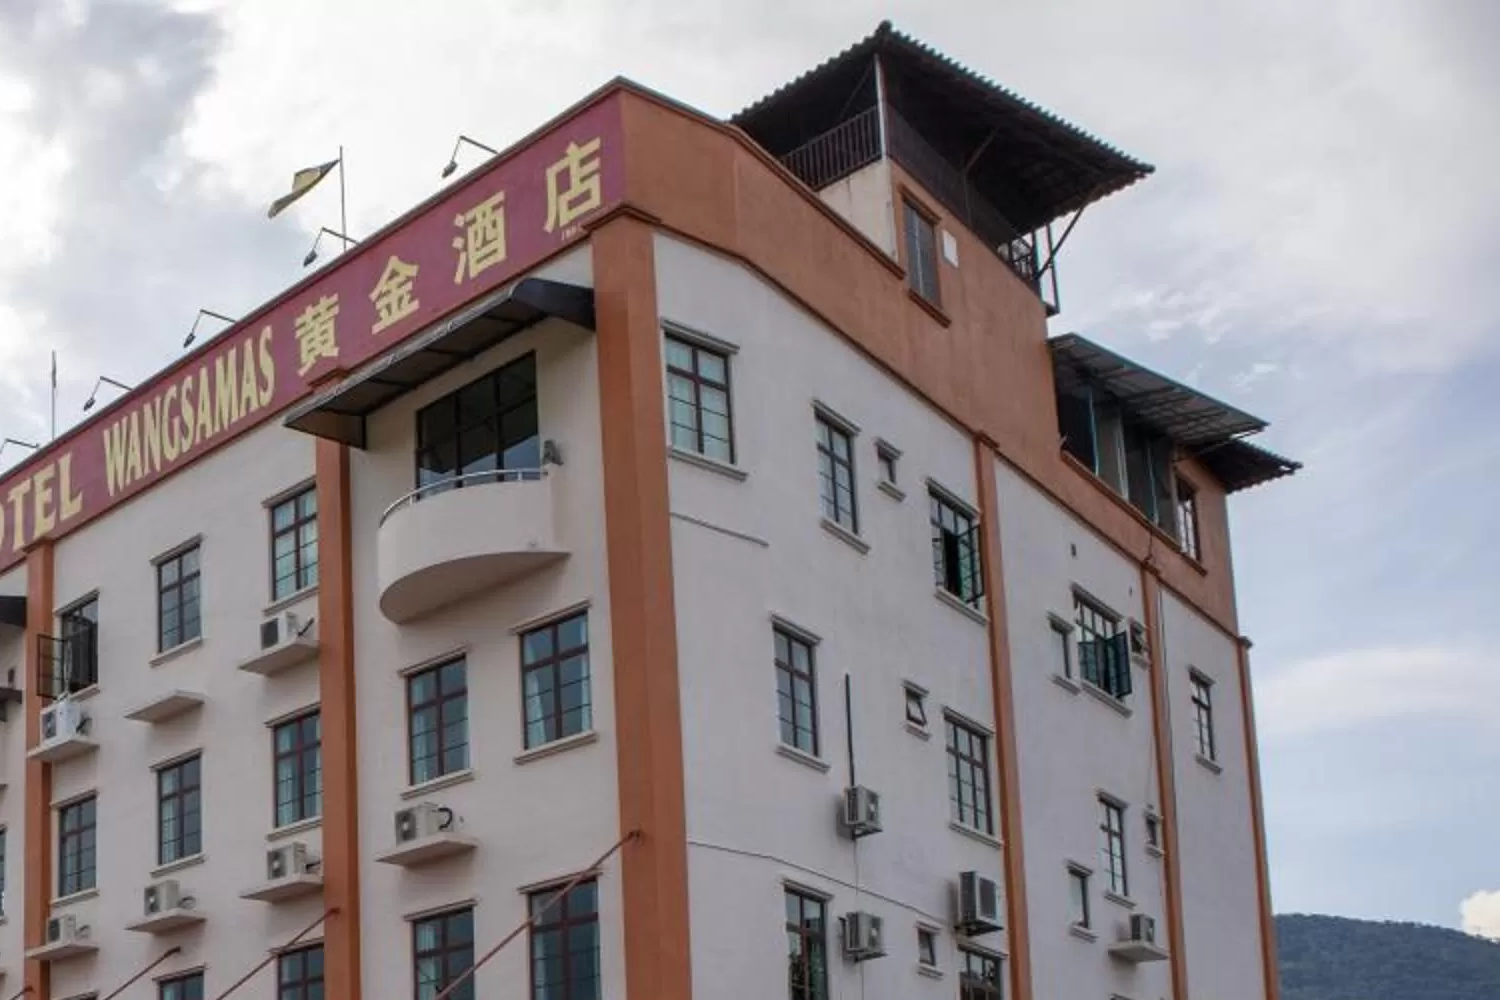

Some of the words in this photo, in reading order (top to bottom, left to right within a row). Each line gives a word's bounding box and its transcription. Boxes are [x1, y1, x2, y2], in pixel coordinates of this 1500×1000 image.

[293, 136, 603, 377] 黄金酒店
[102, 326, 275, 498] WANGSAMAS
